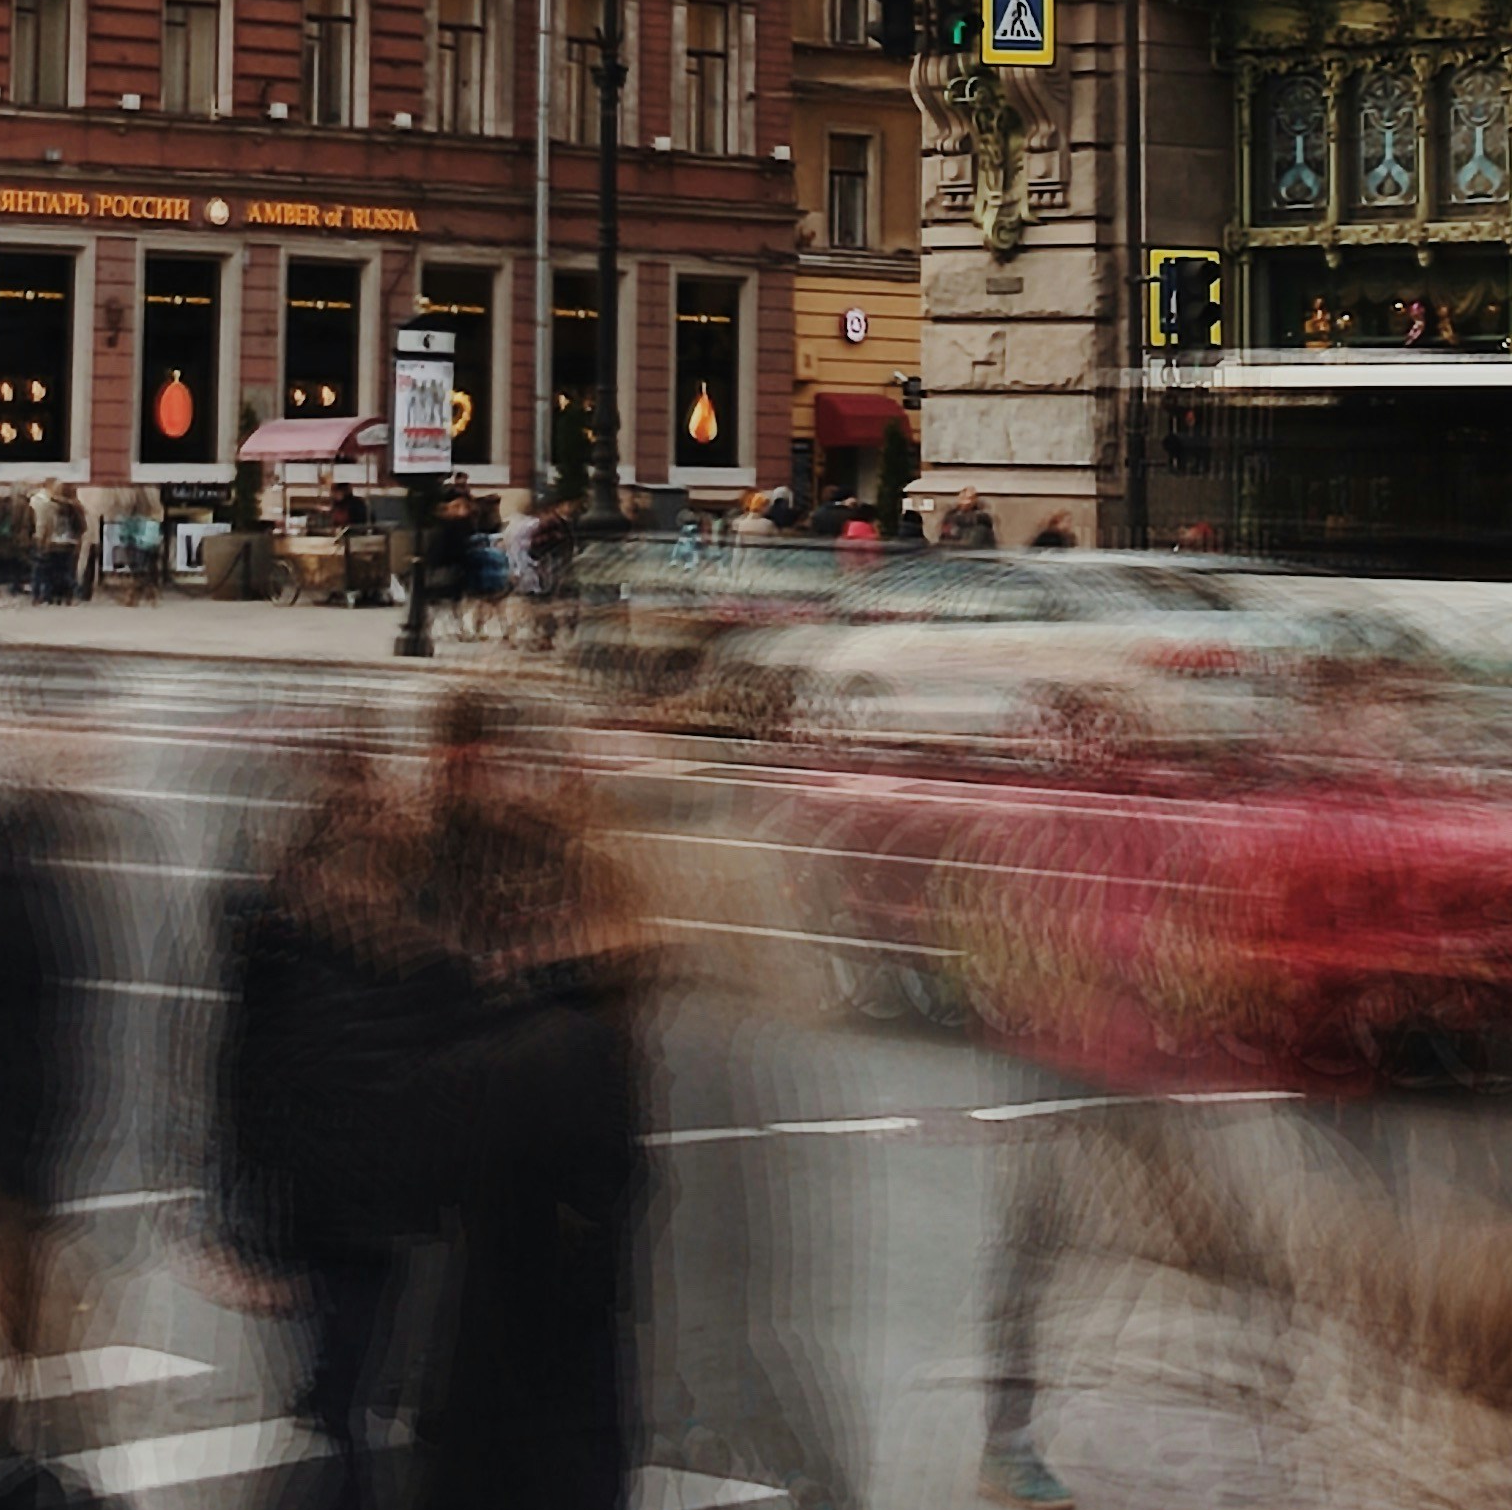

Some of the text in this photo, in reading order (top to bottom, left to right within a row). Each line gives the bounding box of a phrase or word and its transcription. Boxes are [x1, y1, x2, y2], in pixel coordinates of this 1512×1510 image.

[0, 189, 190, 222] ЯНТАРЬ РОССИИ
[247, 201, 419, 232] AMBER of RUSSIA
